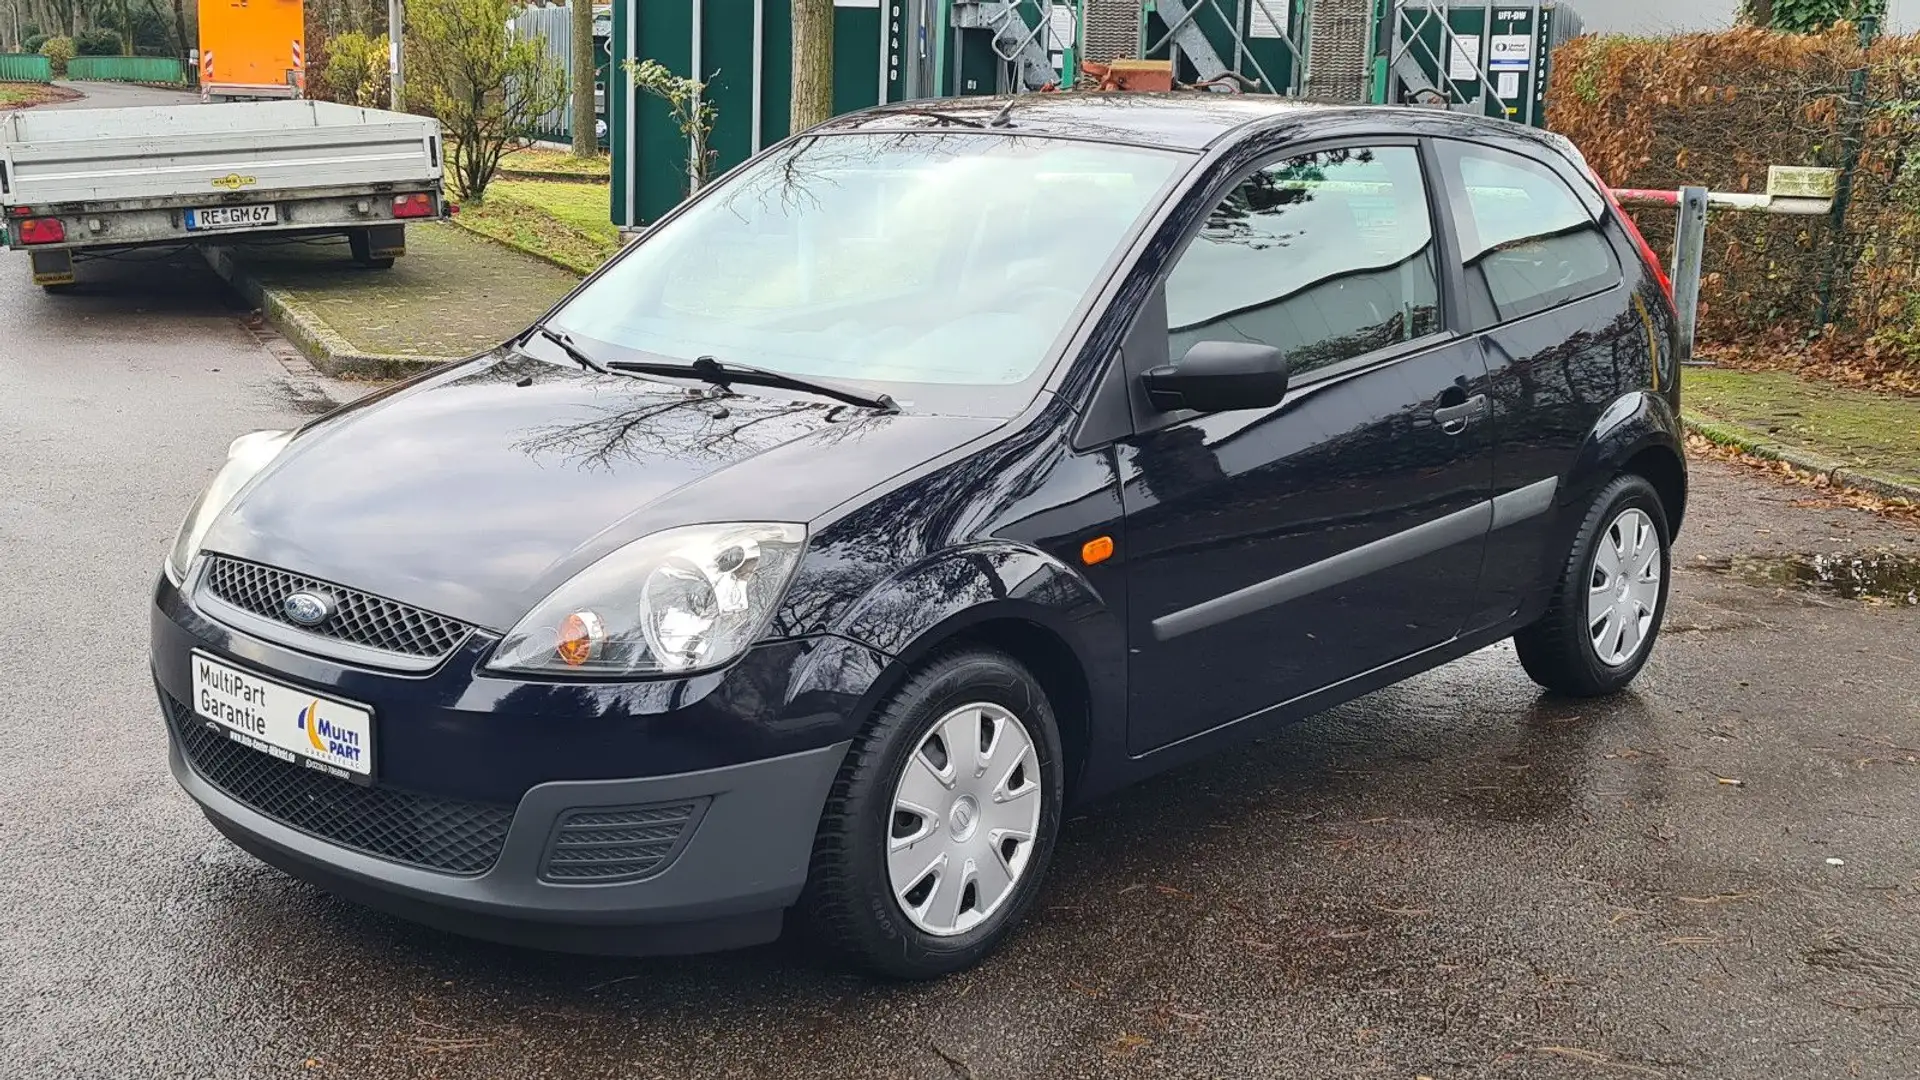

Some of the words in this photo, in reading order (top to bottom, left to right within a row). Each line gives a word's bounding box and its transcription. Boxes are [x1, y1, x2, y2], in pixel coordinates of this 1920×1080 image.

[890, 5, 900, 81] 04460
[201, 210, 221, 225] RE
[230, 207, 250, 222] GM
[252, 206, 270, 221] 67
[200, 662, 266, 707] MultiPart
[201, 688, 266, 735] Garantie
[317, 717, 359, 747] MULTI
[329, 740, 361, 762] PART
